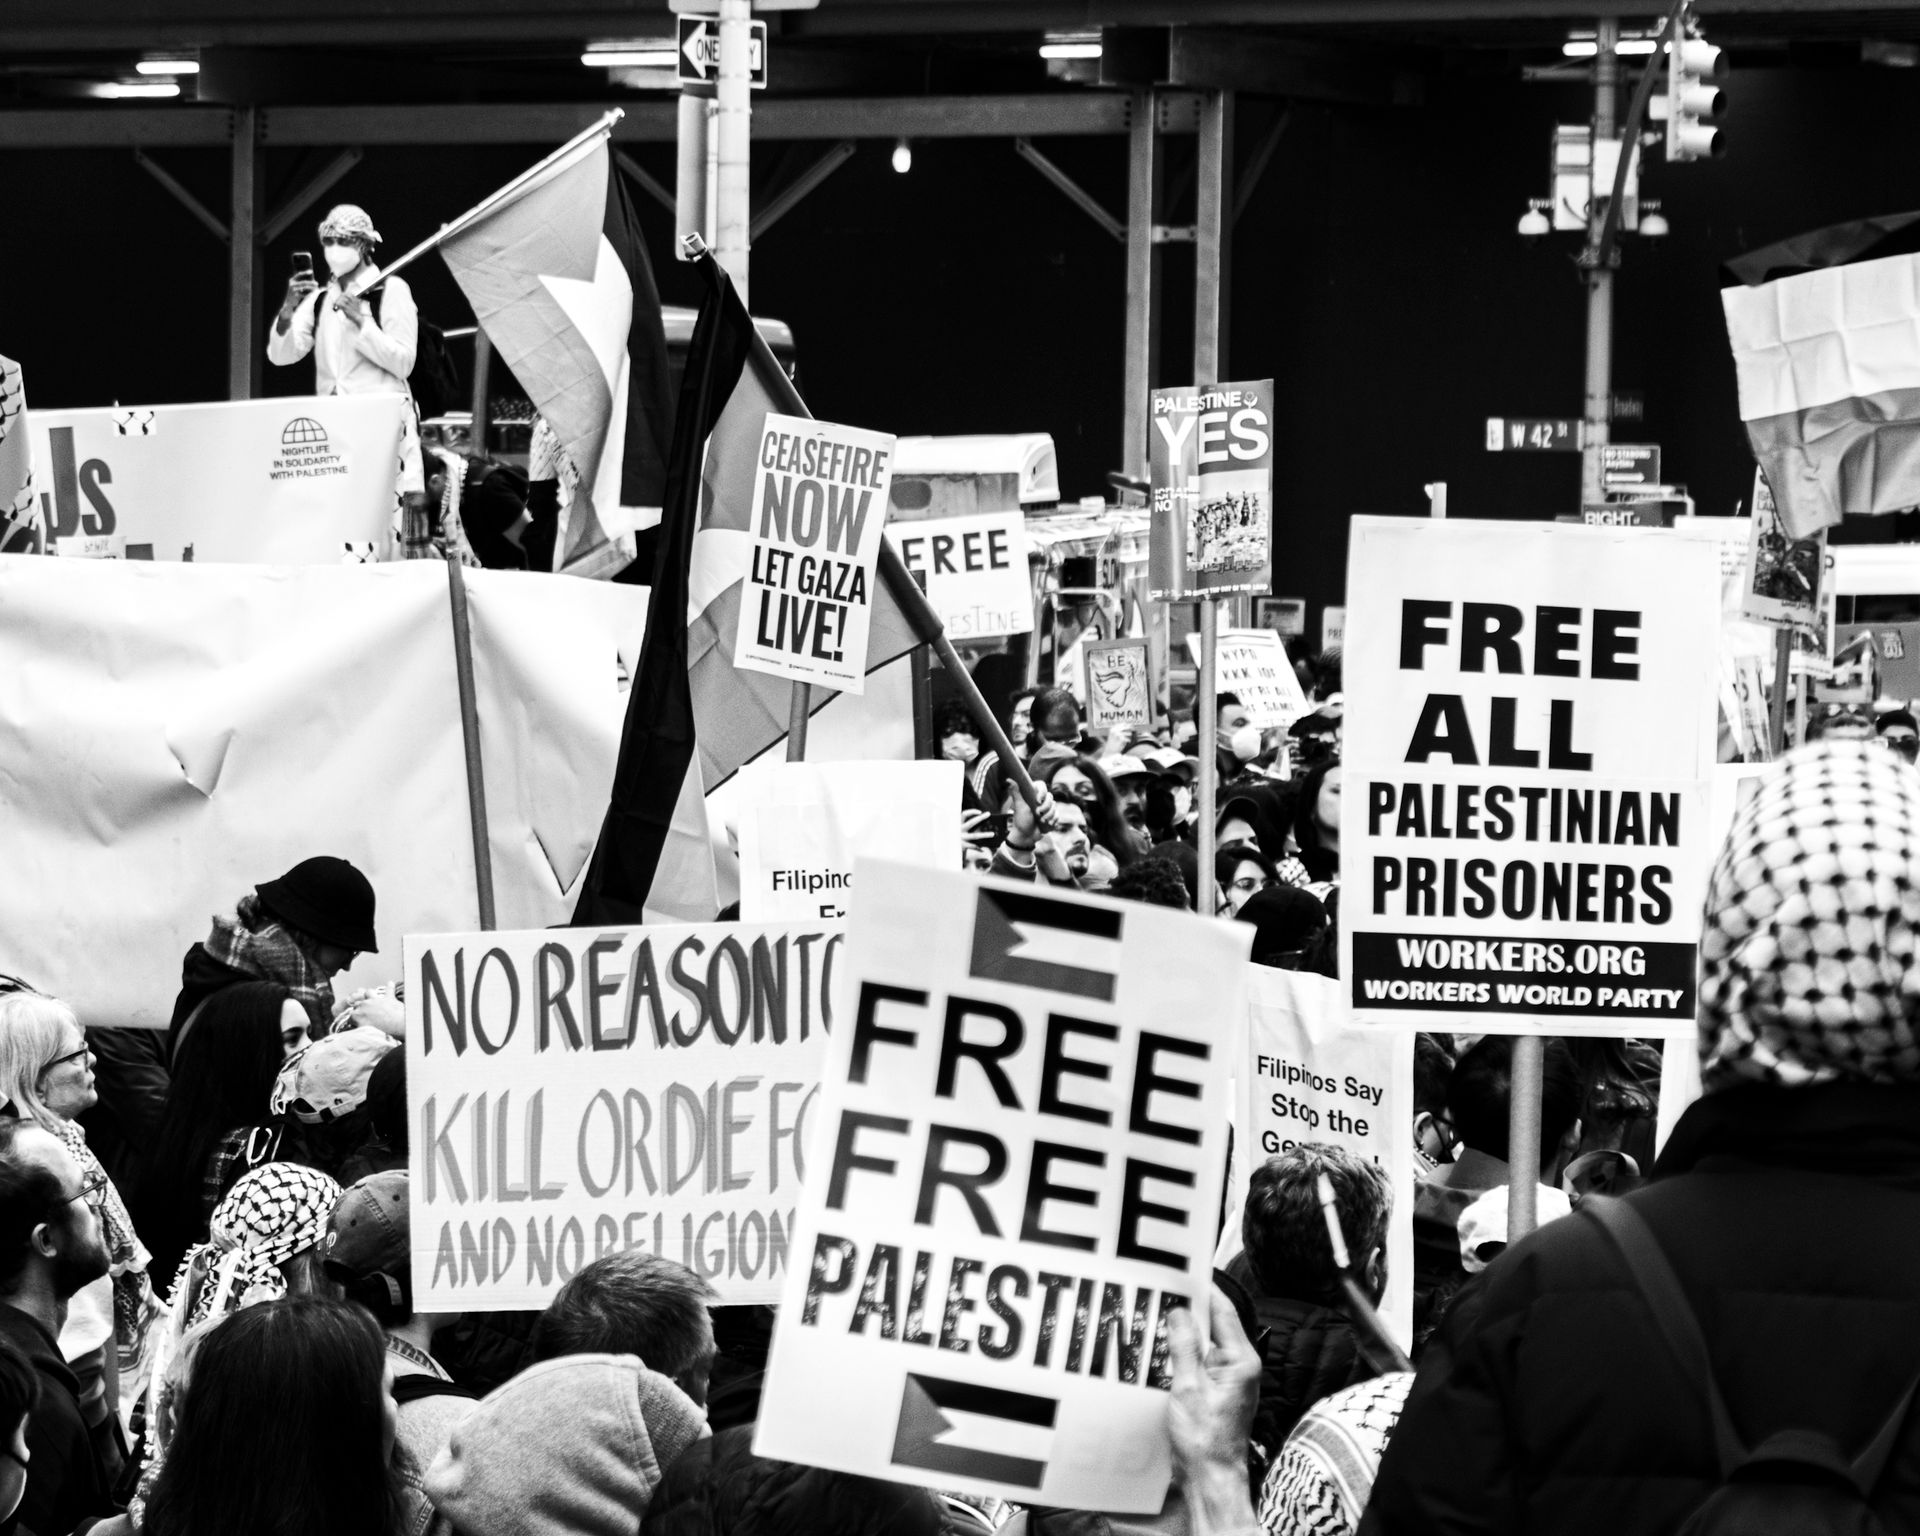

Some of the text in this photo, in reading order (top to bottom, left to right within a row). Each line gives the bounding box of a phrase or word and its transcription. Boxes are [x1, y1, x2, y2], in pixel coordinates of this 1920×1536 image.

[696, 38, 720, 62] ONE
[1154, 391, 1242, 414] PALESTINE
[273, 455, 341, 469] IN SOLIDARITY
[281, 445, 330, 456] NIGHTLIFE
[761, 430, 889, 489] CEASEFIRE
[1155, 408, 1269, 466] YES
[1512, 423, 1526, 449] W
[1530, 423, 1553, 449] 42
[269, 465, 348, 480] WITH PALESTINE
[759, 472, 873, 556] NOW
[1154, 499, 1173, 513] NO
[751, 545, 867, 605] LET GAZA
[902, 528, 1010, 575] FREE
[756, 589, 849, 662] LIVE!
[1399, 598, 1641, 681] FREE
[1107, 655, 1126, 668] BE
[1100, 709, 1144, 721] HUMAN
[1404, 693, 1593, 771] ALL
[1368, 781, 1681, 847] PALESTINIAN
[1373, 856, 1673, 925] PRISONERS
[1398, 938, 1646, 976] WORKERS.ORG
[421, 945, 520, 1058] NO
[534, 932, 788, 1052] REASON
[1363, 979, 1684, 1009] WORKERS WORLD PARTY
[847, 979, 1212, 1146] FREE
[1257, 1055, 1383, 1106] Filipinos Say
[420, 1086, 568, 1206] KILL
[577, 1086, 658, 1199] OR
[659, 1076, 766, 1198] DIE
[1271, 1093, 1369, 1137] Stop the
[825, 1108, 1198, 1271] FREE
[431, 1216, 516, 1290] AND
[526, 1214, 585, 1287] NO
